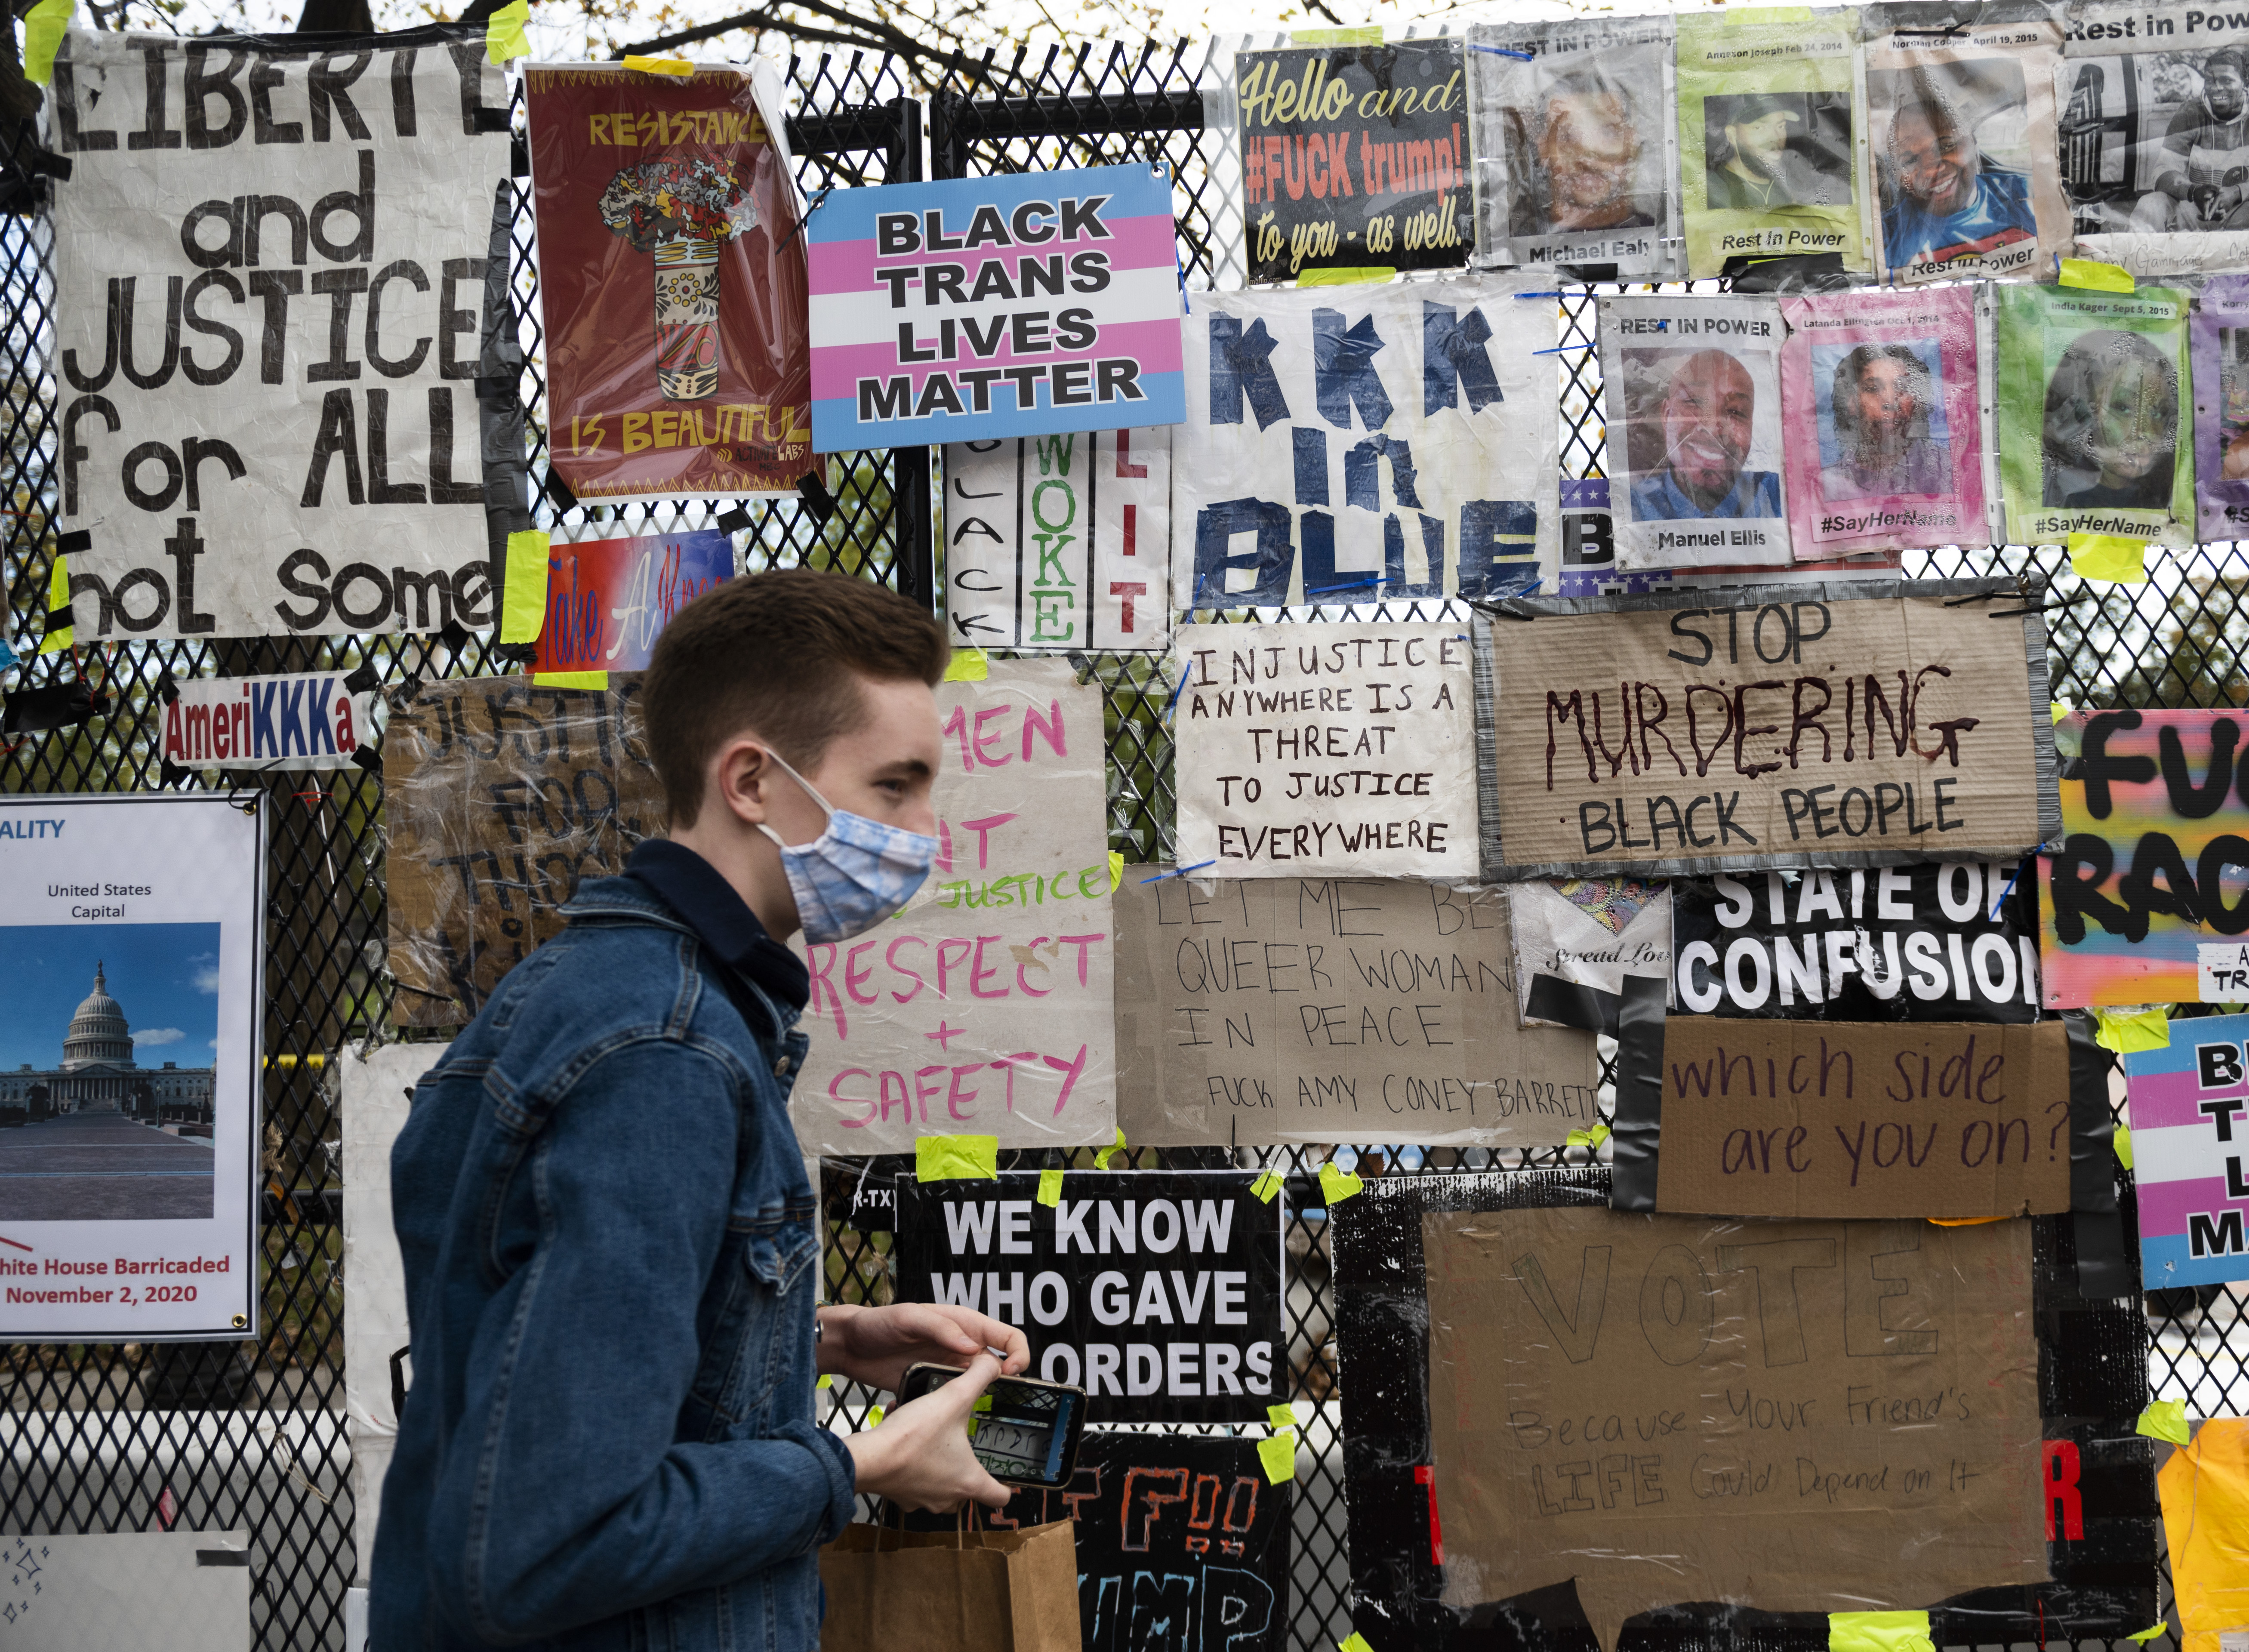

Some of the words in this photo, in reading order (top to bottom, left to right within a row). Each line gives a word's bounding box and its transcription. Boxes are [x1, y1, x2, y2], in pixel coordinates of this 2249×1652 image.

[1556, 36, 1577, 53] IN
[1821, 43, 1842, 51] 2014
[1893, 40, 1931, 49] Norman
[1973, 36, 1996, 46] April
[2000, 36, 2012, 44] 19,
[2015, 34, 2038, 43] 2015
[2065, 16, 2135, 41] Rest
[2147, 15, 2174, 36] in
[52, 33, 487, 152] LIBERTY
[1240, 58, 1354, 127] Hello
[1358, 69, 1461, 118] and
[589, 111, 773, 147] RESISTANCE
[1246, 131, 1354, 204] #FUCK
[1360, 122, 1463, 206] trump!
[181, 149, 376, 268] and
[876, 194, 1115, 258] BLACK
[1257, 210, 1285, 262] to
[1290, 220, 1339, 274] you
[1366, 215, 1394, 253] as
[1404, 194, 1462, 251] well.
[1530, 242, 1605, 263] Michael
[1722, 232, 1762, 250] Rest
[1788, 231, 1845, 246] Power
[1912, 260, 1952, 276] Rest
[874, 249, 1111, 308] TRANS
[1249, 277, 1282, 285] mgflip.com
[62, 258, 487, 393] JUSTICE
[897, 306, 1099, 365] LIVES
[1621, 318, 1671, 335] REST
[1678, 318, 1698, 333] IN
[1705, 318, 1771, 337] POWER
[1804, 319, 1841, 328] Latanda
[2051, 301, 2077, 312] India
[2079, 302, 2108, 313] Kager
[2113, 304, 2136, 315] Sept
[2137, 305, 2146, 316] 5,
[2148, 306, 2169, 316] 2015
[856, 357, 1148, 423] MATTER
[63, 394, 247, 517] for
[300, 387, 486, 508] ALL
[572, 411, 606, 456] IS
[623, 404, 810, 455] BEAUTIFUL
[1029, 433, 1077, 642] WOKE
[1658, 530, 1725, 549] Manuel
[1731, 529, 1766, 546] Ellis
[1821, 510, 1957, 533] #SayHerName
[2035, 514, 2162, 537] #SayHerName
[69, 518, 216, 636] not
[1192, 496, 1542, 610] BLUE
[545, 555, 603, 671] Take
[606, 552, 657, 660] A
[658, 543, 723, 628] Kn
[1667, 601, 1832, 667] STOP
[1192, 638, 1463, 687] INJUSTICE
[166, 678, 356, 761] AmeriKKKa
[1192, 687, 1352, 719] ANYWHERE
[1366, 683, 1413, 713] IS
[1432, 683, 1454, 710] A
[1546, 664, 1981, 791] MURDERING
[1248, 725, 1395, 763] THREAT
[2058, 710, 2249, 820] FU
[489, 769, 643, 845] FOR
[1217, 776, 1261, 807] TO
[1285, 771, 1434, 799] JUSTICE
[1578, 790, 1759, 855] BLACK
[1780, 777, 1965, 841] PEOPLE
[1218, 820, 1448, 860] EVERYWHERE
[48, 883, 99, 897] United
[104, 884, 151, 896] States
[430, 848, 607, 917] THO
[937, 865, 1107, 908] JUSTICE
[1154, 879, 1254, 928] LET
[1299, 880, 1385, 938] ME
[1714, 867, 1914, 928] STATE
[1937, 860, 2018, 924] OF
[71, 904, 125, 920] Capital
[804, 934, 1106, 1040] RESPECT
[1175, 937, 1333, 994] QUEER
[1349, 947, 1513, 994] WOMAN
[1677, 929, 2040, 1013] CONFUSION
[1174, 1008, 1254, 1048] IN
[1298, 1004, 1454, 1047] PEACE
[829, 1043, 1087, 1128] SAFETY
[1207, 1075, 1275, 1109] FUCK
[1298, 1076, 1358, 1113] AMY
[1383, 1074, 1477, 1117] CONEY
[1494, 1077, 1598, 1120] BARRETT
[1672, 1035, 1854, 1100] which
[1885, 1032, 2007, 1105] side
[1722, 1122, 1812, 1175] are
[1836, 1119, 1938, 1187] you
[943, 1200, 1033, 1255] WE
[1054, 1199, 1234, 1254] KNOW
[45, 1259, 108, 1275] House
[114, 1255, 230, 1275] Barricaded
[6, 1286, 114, 1304] November
[120, 1286, 138, 1306] 2,
[145, 1285, 197, 1303] 2020
[930, 1270, 1069, 1326] WHO
[1090, 1270, 1248, 1326] GAVE
[1511, 1222, 1939, 1368] VOTE
[1040, 1341, 1272, 1398] ORDERS
[1510, 1410, 1688, 1449] Because
[1726, 1388, 1818, 1432] Your
[1847, 1385, 1971, 1427] Friend's
[1531, 1453, 1670, 1518] LIFE
[1690, 1453, 1772, 1501] Could
[1796, 1455, 1889, 1504] Depend
[1903, 1467, 1932, 1495] on
